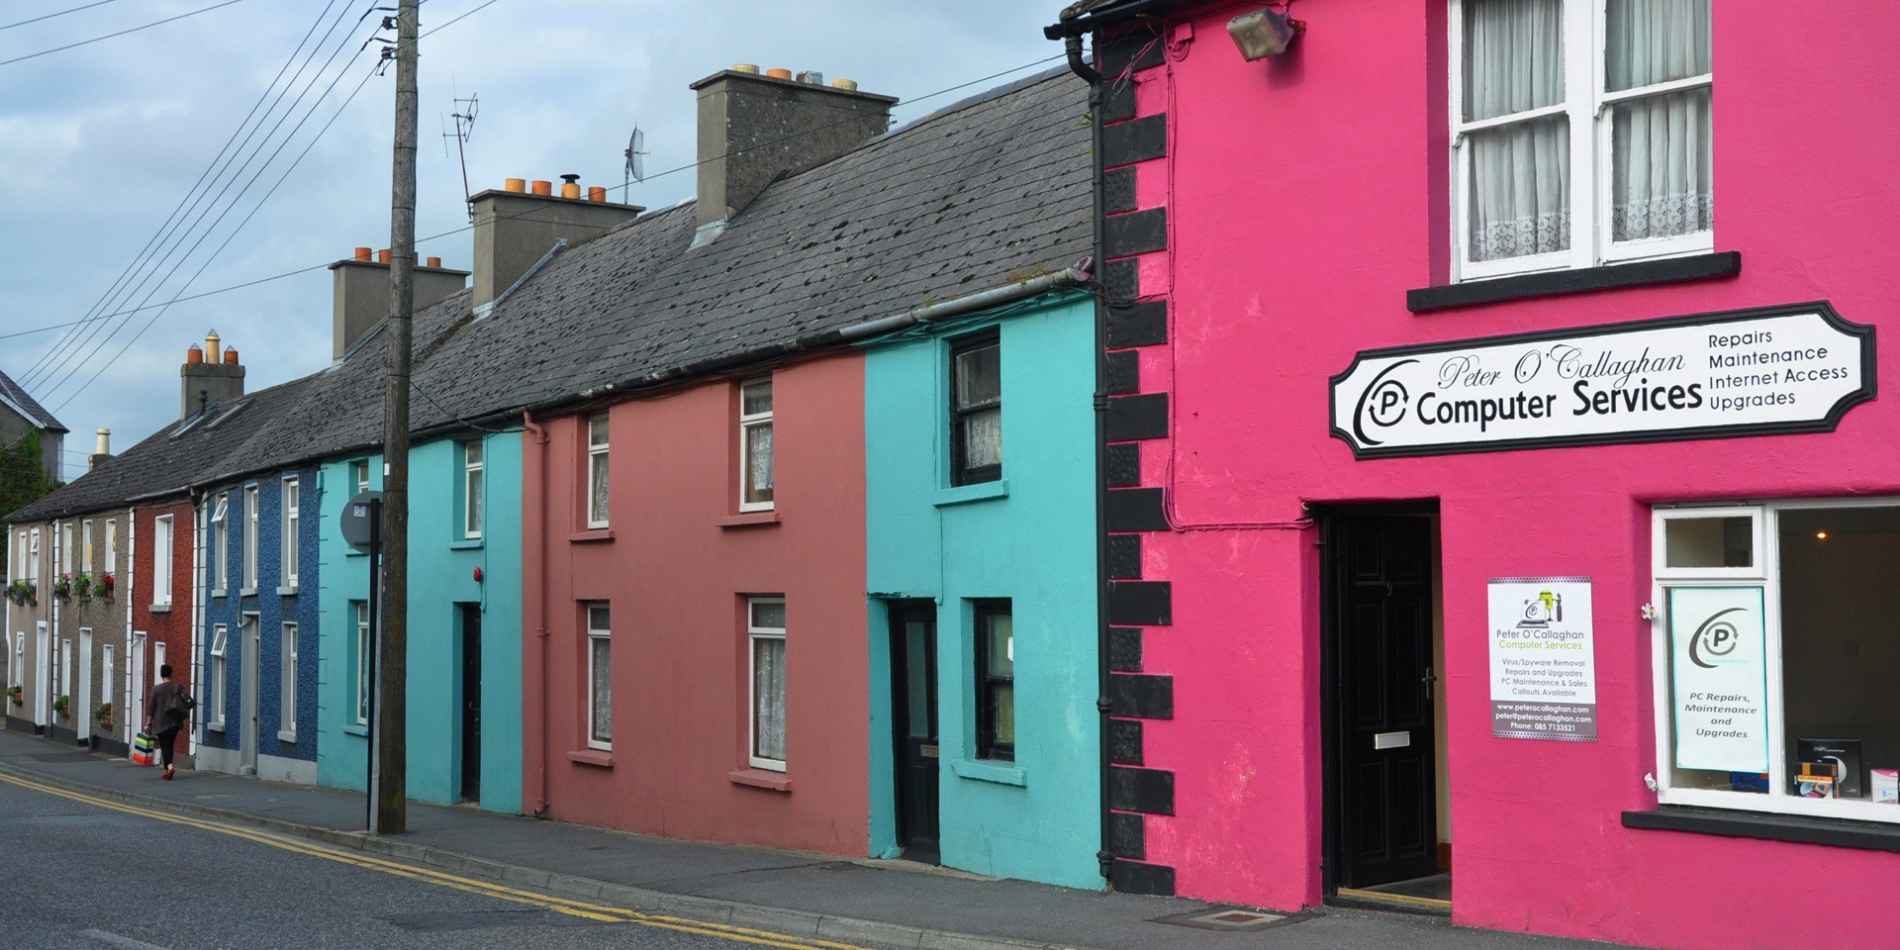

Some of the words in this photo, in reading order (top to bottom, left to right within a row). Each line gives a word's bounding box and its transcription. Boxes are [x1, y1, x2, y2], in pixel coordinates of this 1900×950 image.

[1708, 331, 1773, 348] Repairs
[1709, 347, 1828, 369] Maintenance
[1438, 355, 1501, 389] Peter
[1514, 344, 1686, 389] O'Callaghan
[1709, 371, 1778, 389] Internet
[1784, 367, 1848, 383] Access
[1416, 391, 1557, 432] Computer
[1573, 378, 1703, 415] Services
[1710, 392, 1796, 411] Upgrades
[1496, 629, 1520, 639] Peter
[1523, 629, 1585, 641] O'Callaghan
[1499, 640, 1542, 650] Computer
[1545, 640, 1583, 650] Services
[1553, 659, 1586, 667] Removal
[1505, 668, 1530, 677] Repairs
[1548, 669, 1583, 678] Upgrades
[1513, 678, 1559, 687] Maintenance
[1561, 679, 1567, 687] &
[1568, 679, 1588, 687] Sales
[1542, 689, 1576, 697] Available
[1689, 692, 1704, 701] PC
[1706, 693, 1750, 703] Repairs,
[1684, 704, 1758, 715] Maintenance
[1710, 718, 1733, 726] and
[1695, 728, 1749, 739] Upgrades
